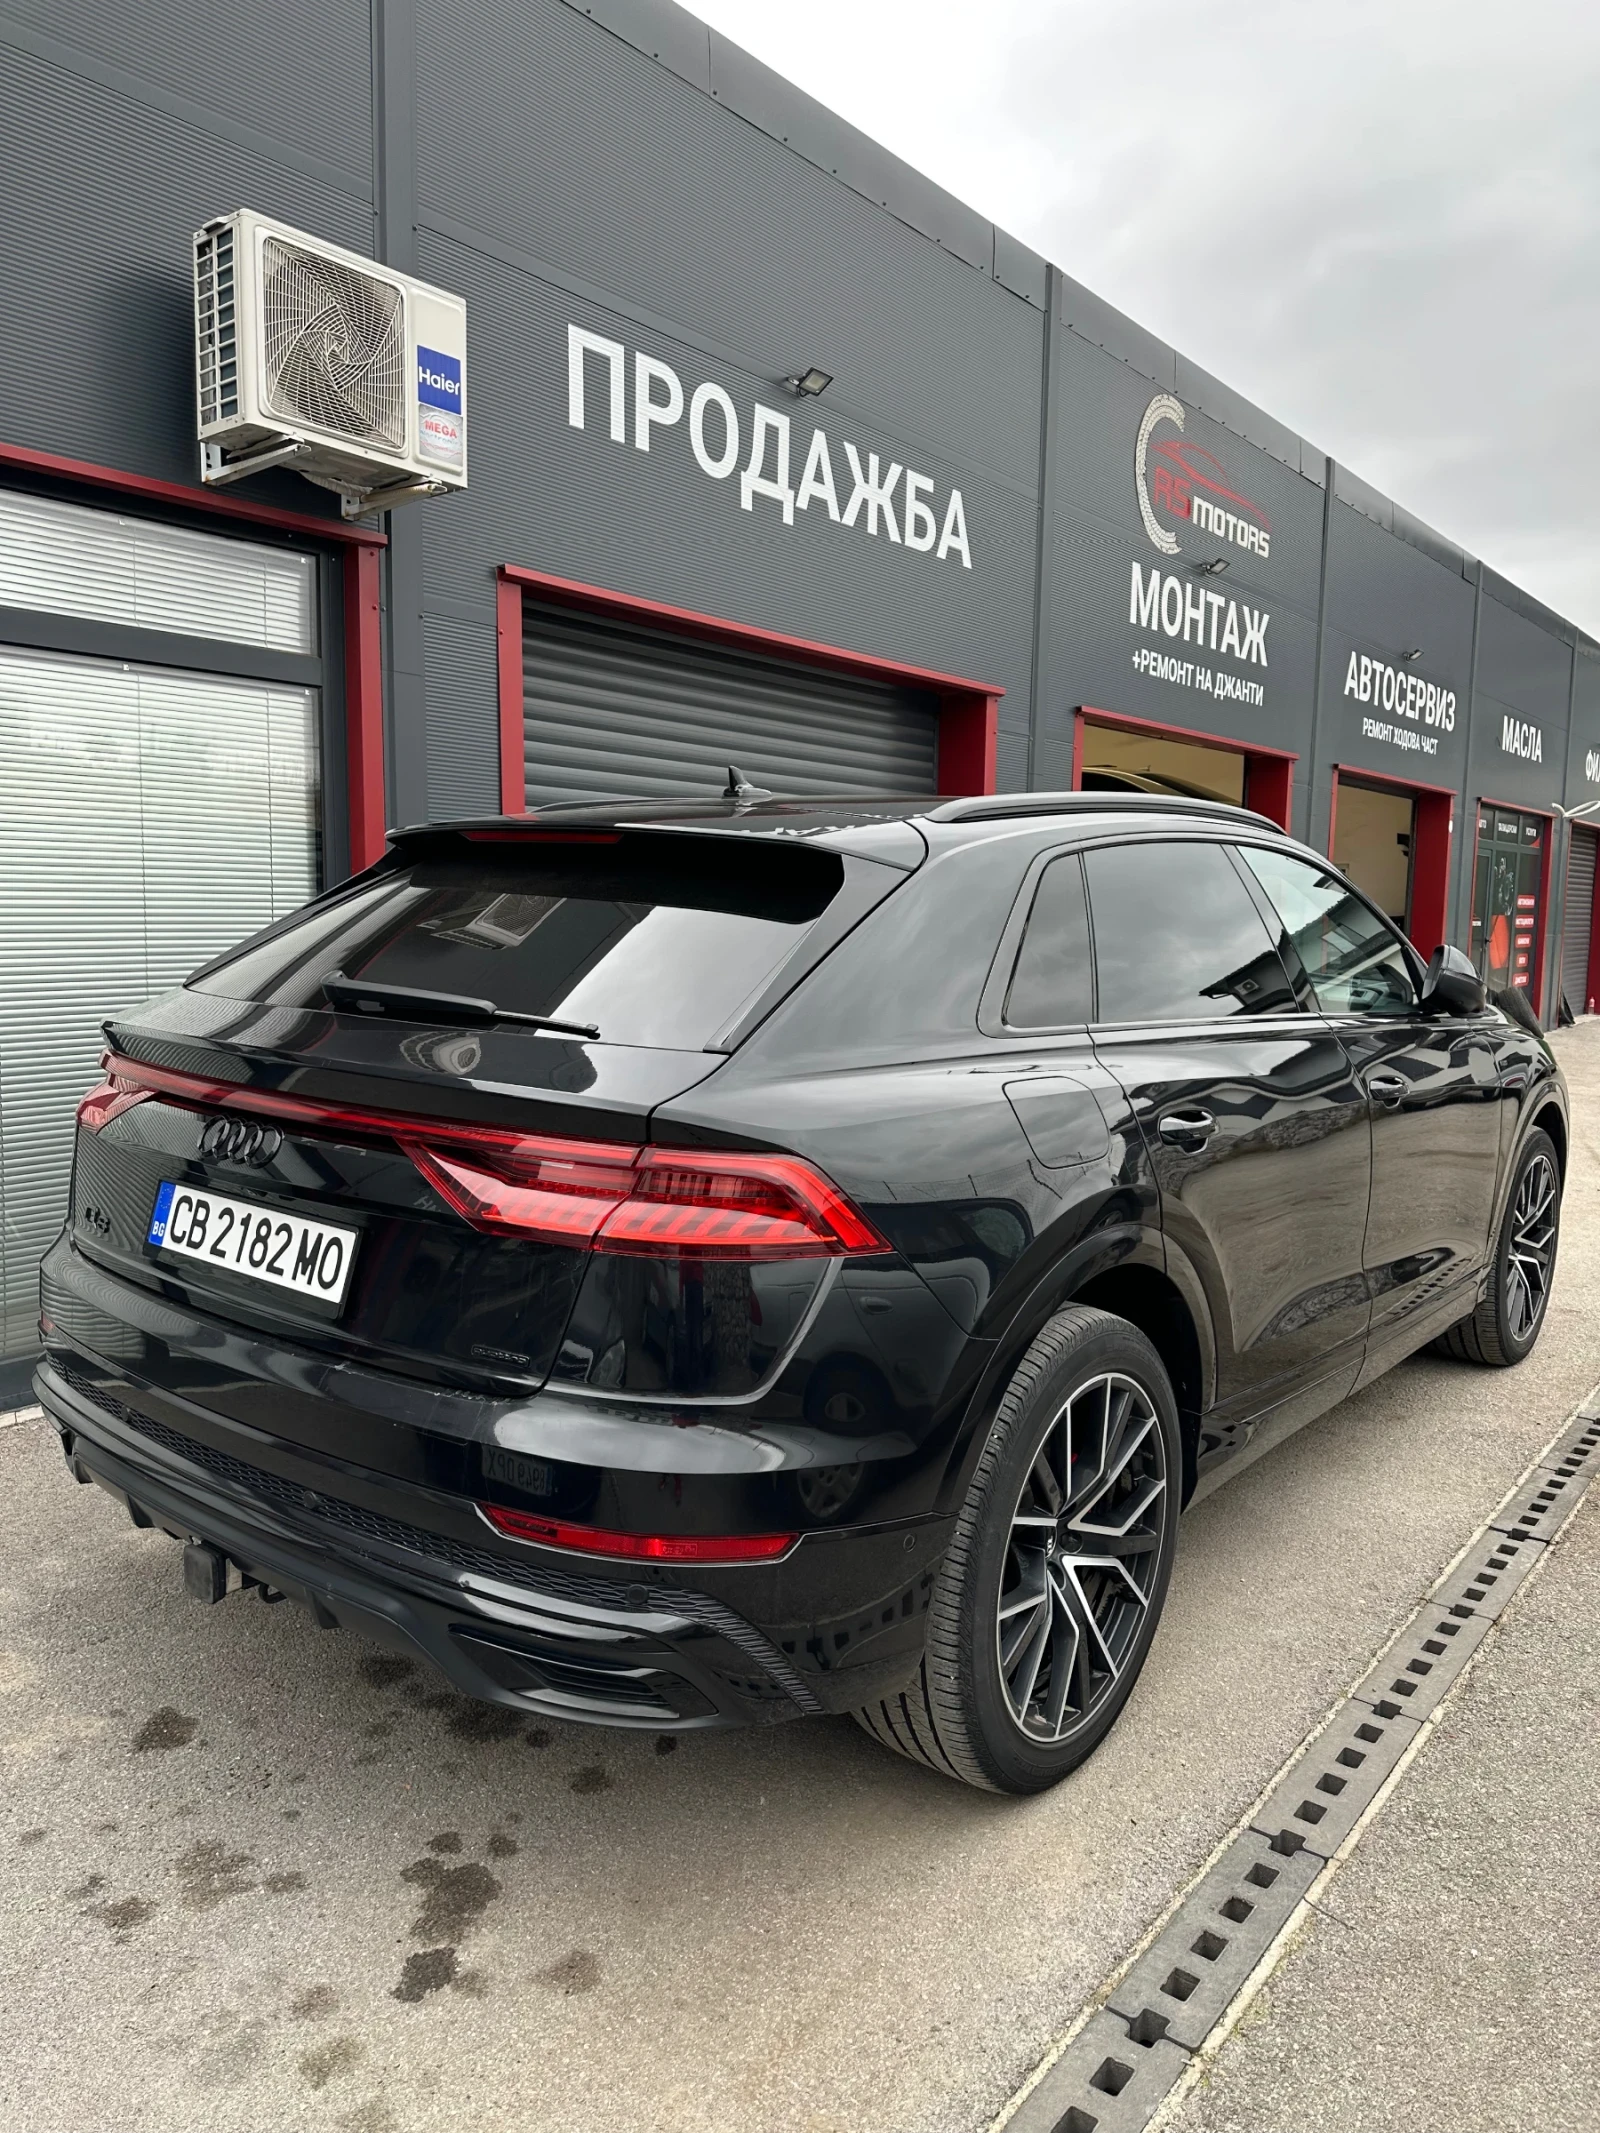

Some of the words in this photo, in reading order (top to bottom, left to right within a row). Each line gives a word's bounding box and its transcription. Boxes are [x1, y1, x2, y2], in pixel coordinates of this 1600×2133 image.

[418, 366, 460, 396] Haier
[424, 419, 458, 439] MEGA
[568, 324, 972, 569] ПРОДАЖБА
[1153, 466, 1191, 520] RS
[1193, 495, 1271, 559] MOTORS
[1130, 561, 1270, 667] МОНТАЖ
[1132, 648, 1195, 687] +РЕМОНТ
[1195, 666, 1213, 692] НА
[1213, 672, 1264, 706] ДЖАНТИ
[1344, 651, 1456, 732] АВТОСЕРВИЗ
[1362, 717, 1394, 742] РЕМОНТ
[1393, 726, 1421, 751] ХОДОВА
[1421, 735, 1439, 756] ЧАСТ
[1502, 715, 1543, 764] МАСЛА
[152, 1221, 166, 1237] BG
